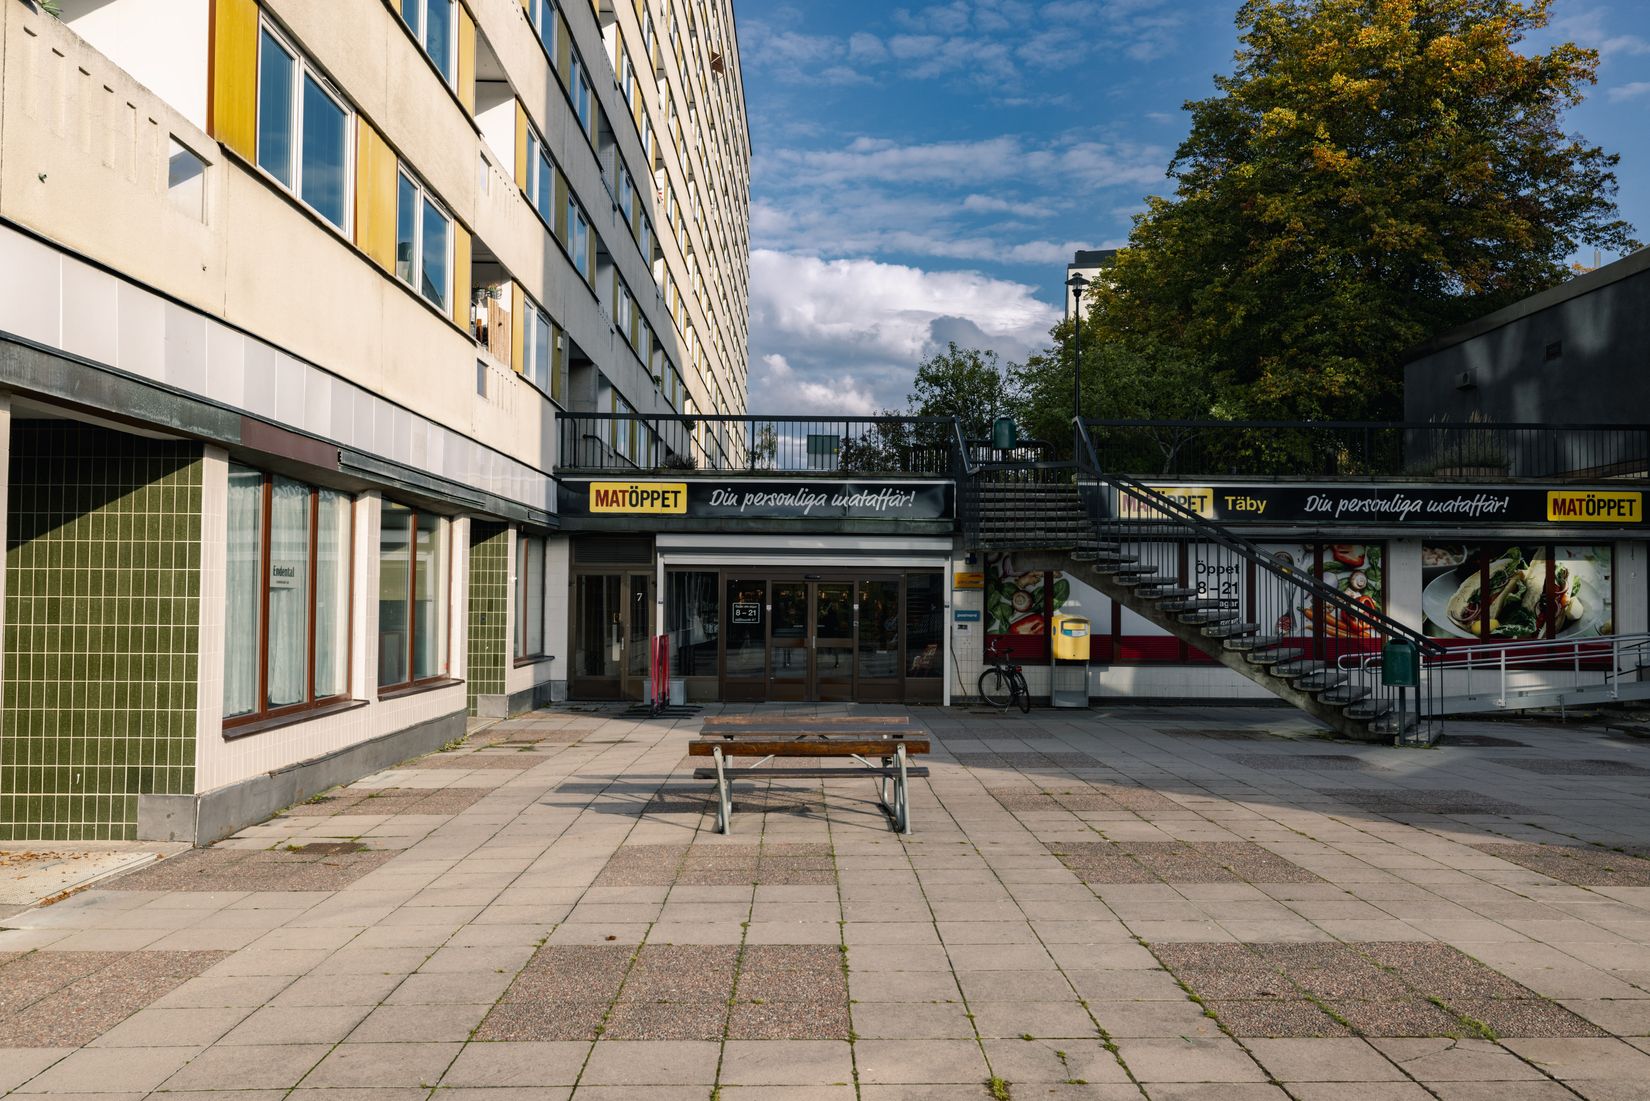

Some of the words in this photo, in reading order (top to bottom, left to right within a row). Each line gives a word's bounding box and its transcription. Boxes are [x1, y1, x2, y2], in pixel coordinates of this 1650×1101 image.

[595, 486, 681, 508] MATÖPPET
[709, 488, 737, 506] Din
[739, 488, 827, 515] personliga
[831, 488, 916, 511] mataffär!
[1224, 496, 1267, 514] Täby
[1552, 494, 1636, 517] MATÖPPET
[1304, 494, 1332, 512] Din
[1335, 494, 1423, 521] personliga
[1427, 494, 1509, 517] mataffär!
[273, 565, 295, 577] Endental
[1196, 560, 1239, 576] Öppet
[636, 592, 643, 602] 7
